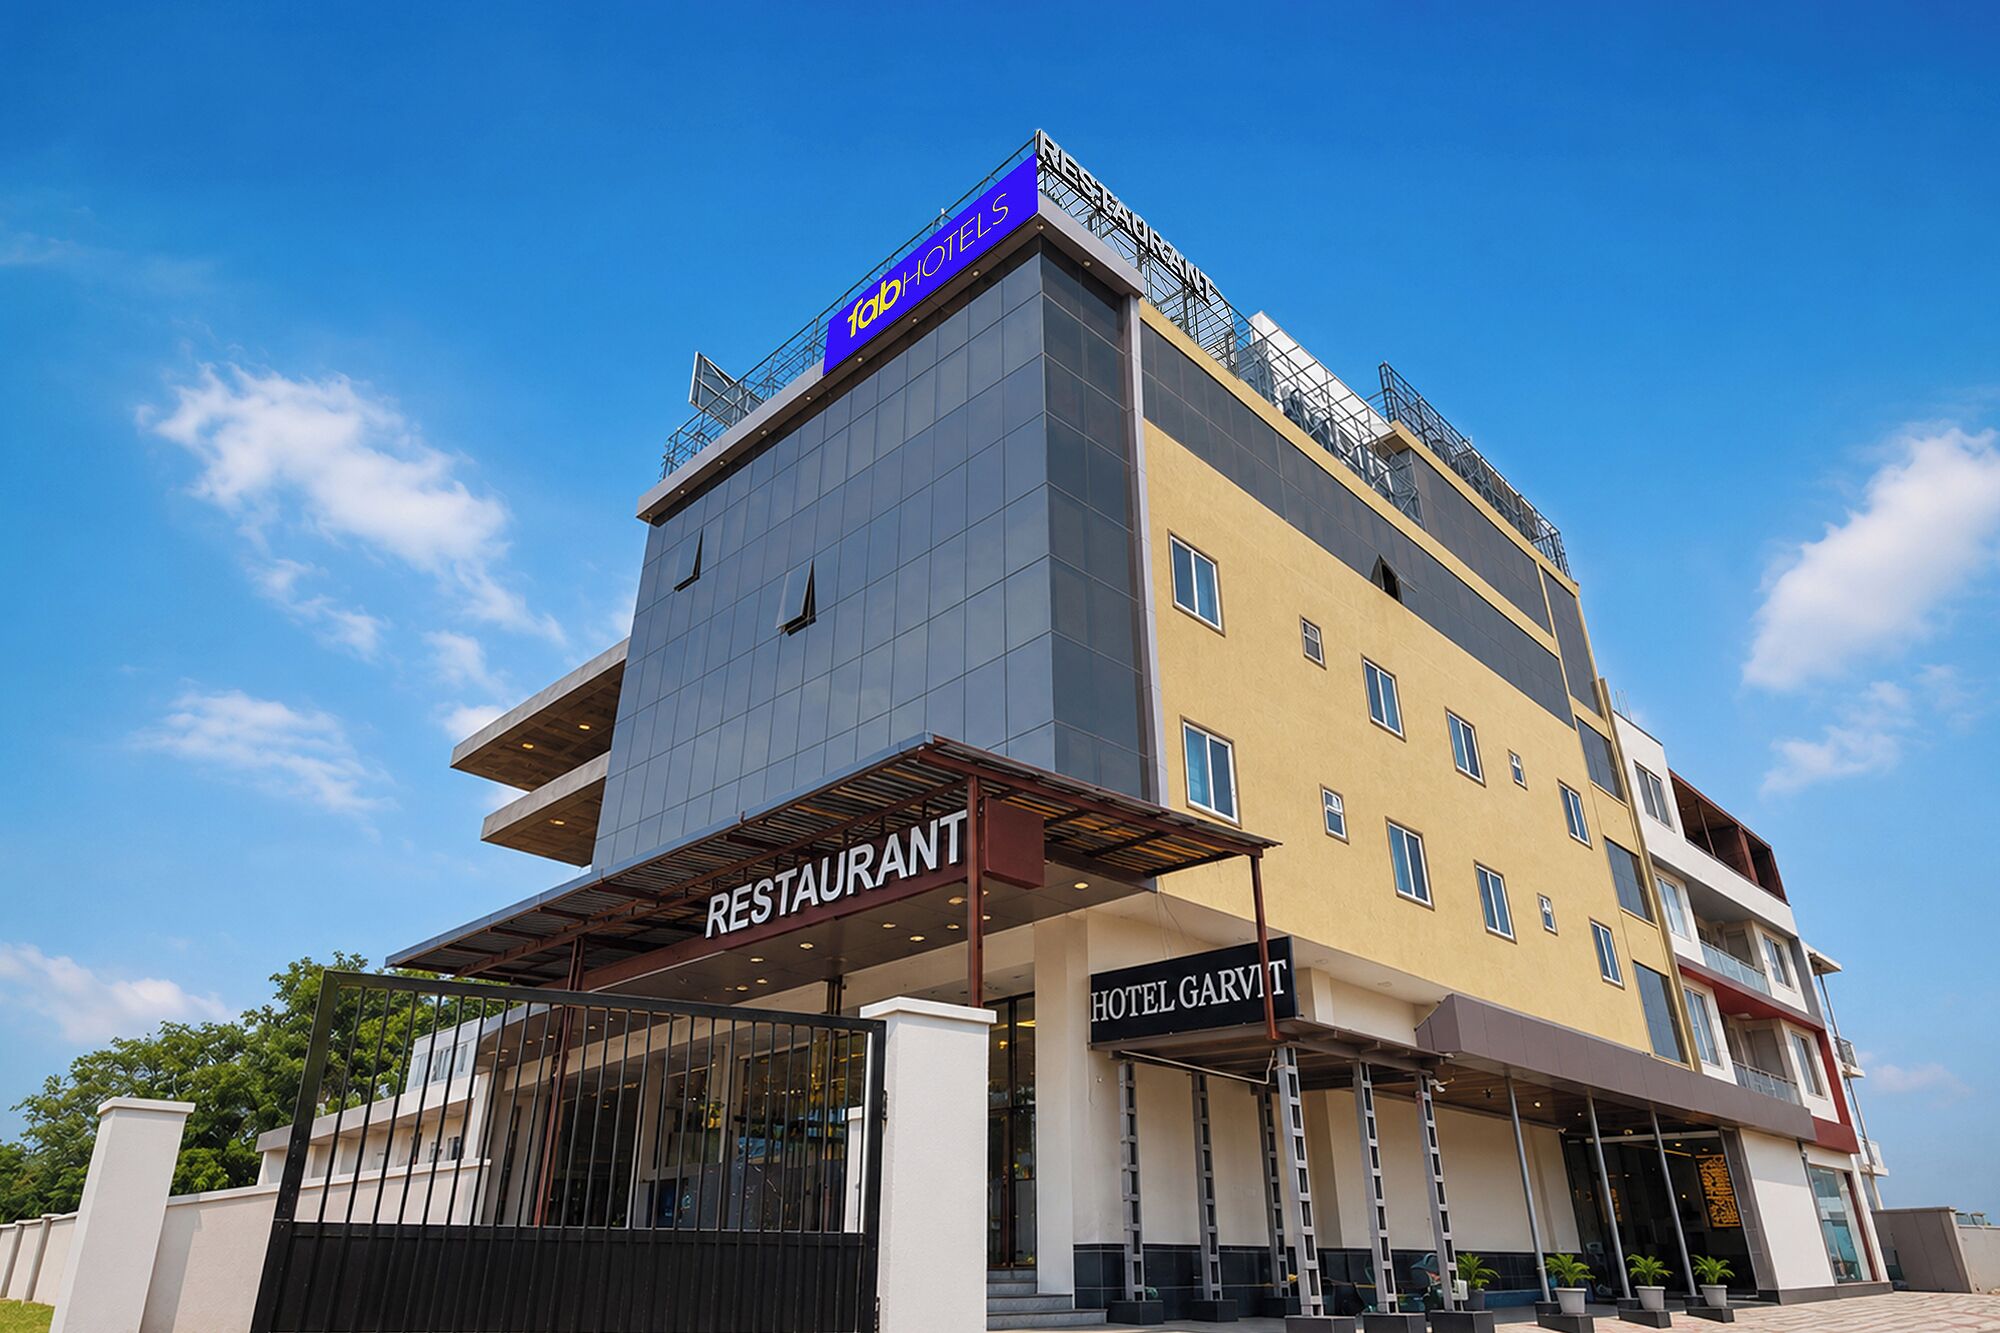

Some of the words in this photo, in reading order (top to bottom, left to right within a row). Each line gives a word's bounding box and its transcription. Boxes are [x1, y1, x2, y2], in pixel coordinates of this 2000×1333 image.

[847, 192, 1009, 338] fabHOTELS
[1037, 129, 1217, 305] RESTAURANT
[705, 809, 967, 939] RESTAURANT
[1091, 980, 1175, 1022] HOTEL
[1179, 959, 1288, 1009] GARVIT
